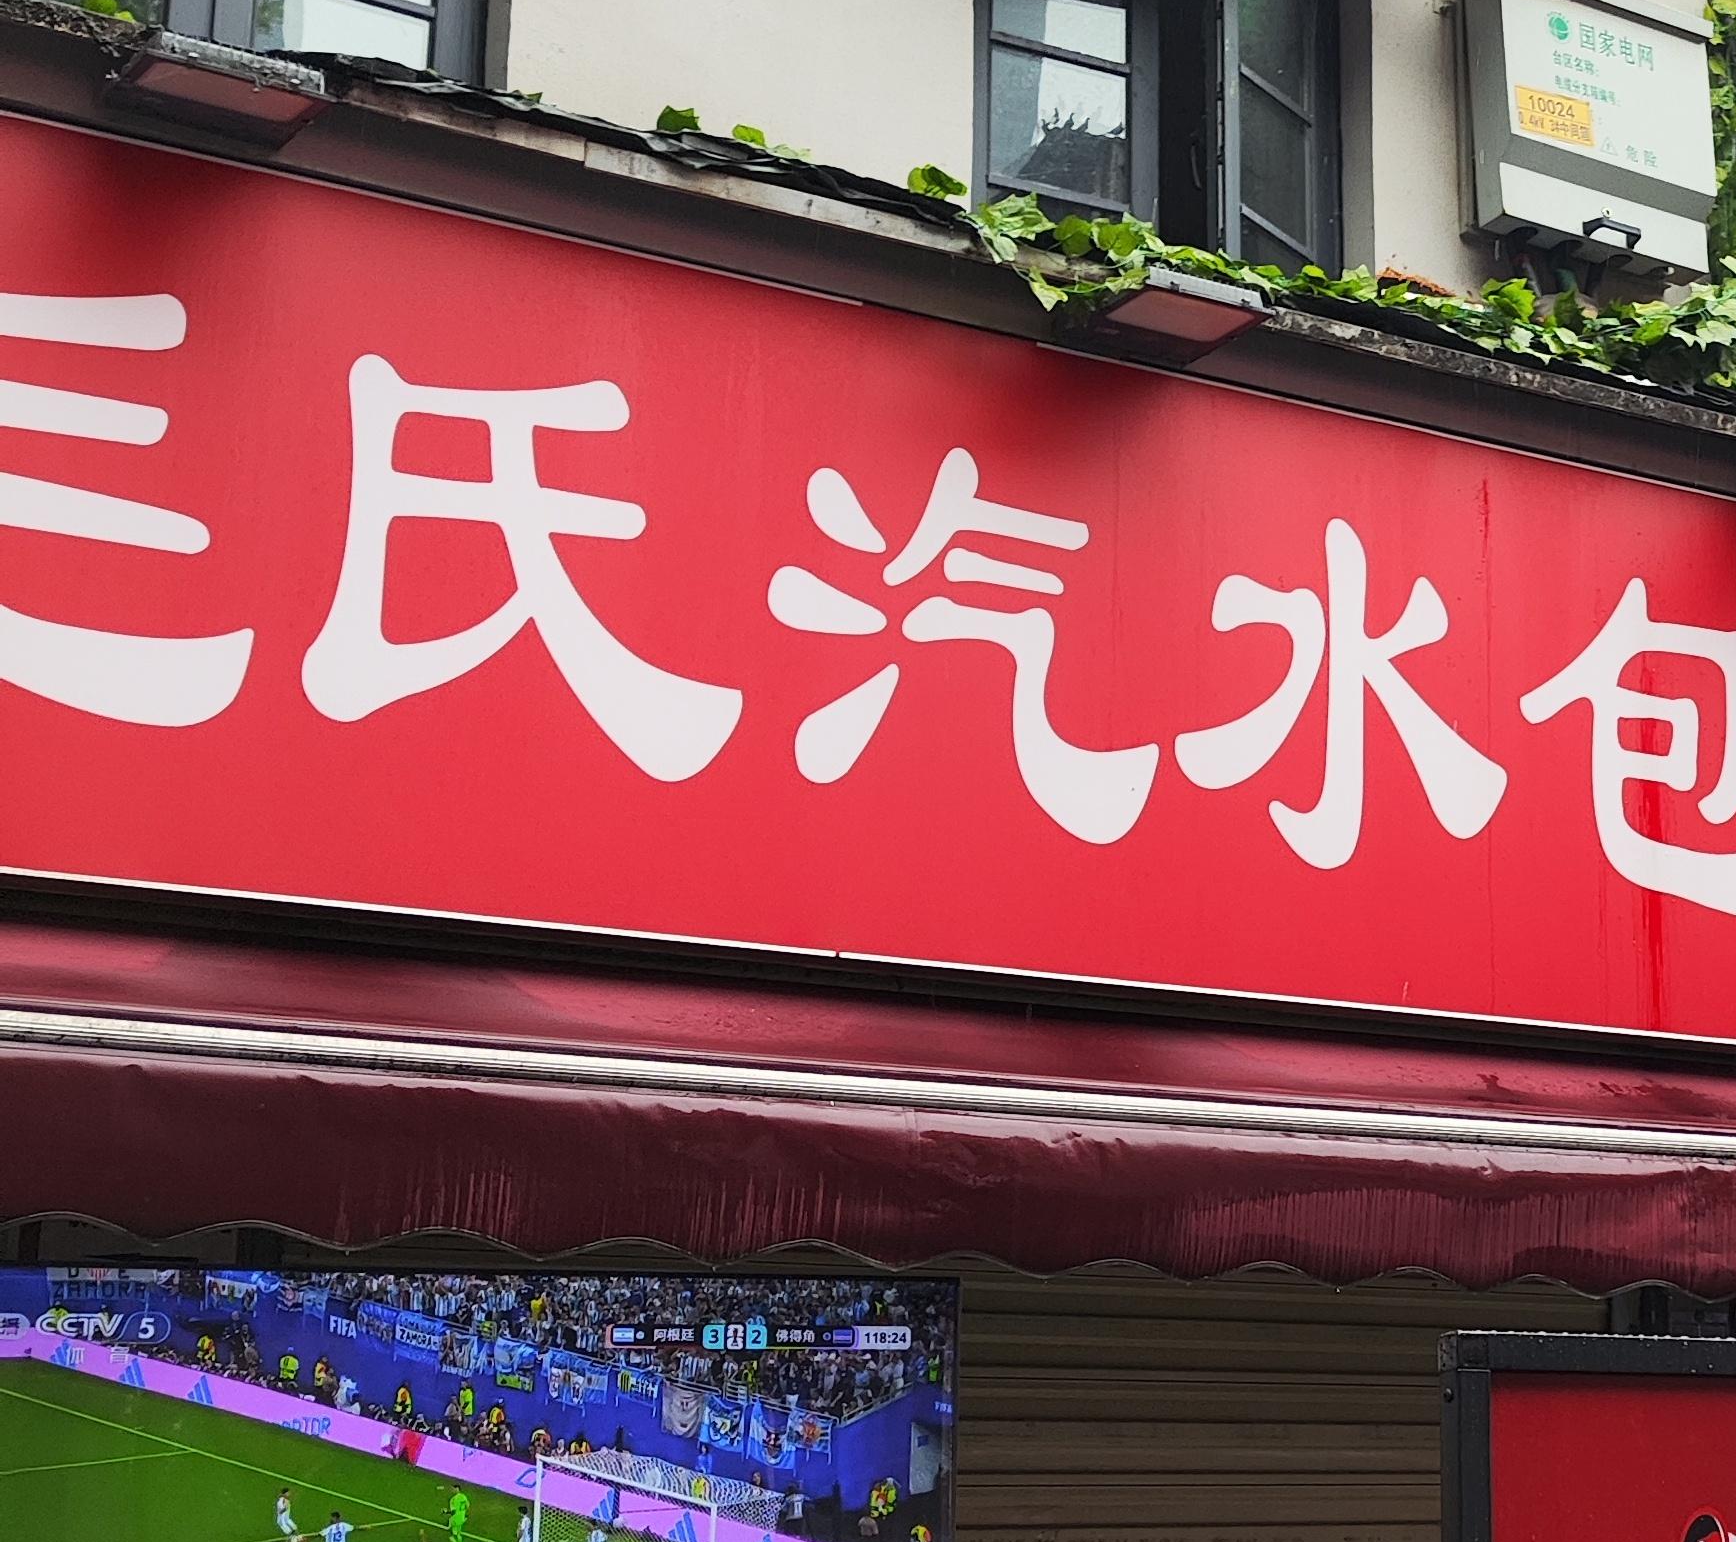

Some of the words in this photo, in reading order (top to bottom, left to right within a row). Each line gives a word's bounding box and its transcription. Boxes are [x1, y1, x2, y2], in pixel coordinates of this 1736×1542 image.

[1579, 22, 1655, 71] 国家电网
[1528, 95, 1575, 119] 10024
[36, 1313, 124, 1337] CCTV
[138, 1318, 155, 1339] 5
[329, 1315, 357, 1339] FIFA
[653, 1328, 695, 1341] 阿根廷
[709, 1330, 719, 1343] 3
[752, 1330, 761, 1344] 2
[775, 1329, 815, 1343] 佛得角
[864, 1331, 907, 1344] 118:24
